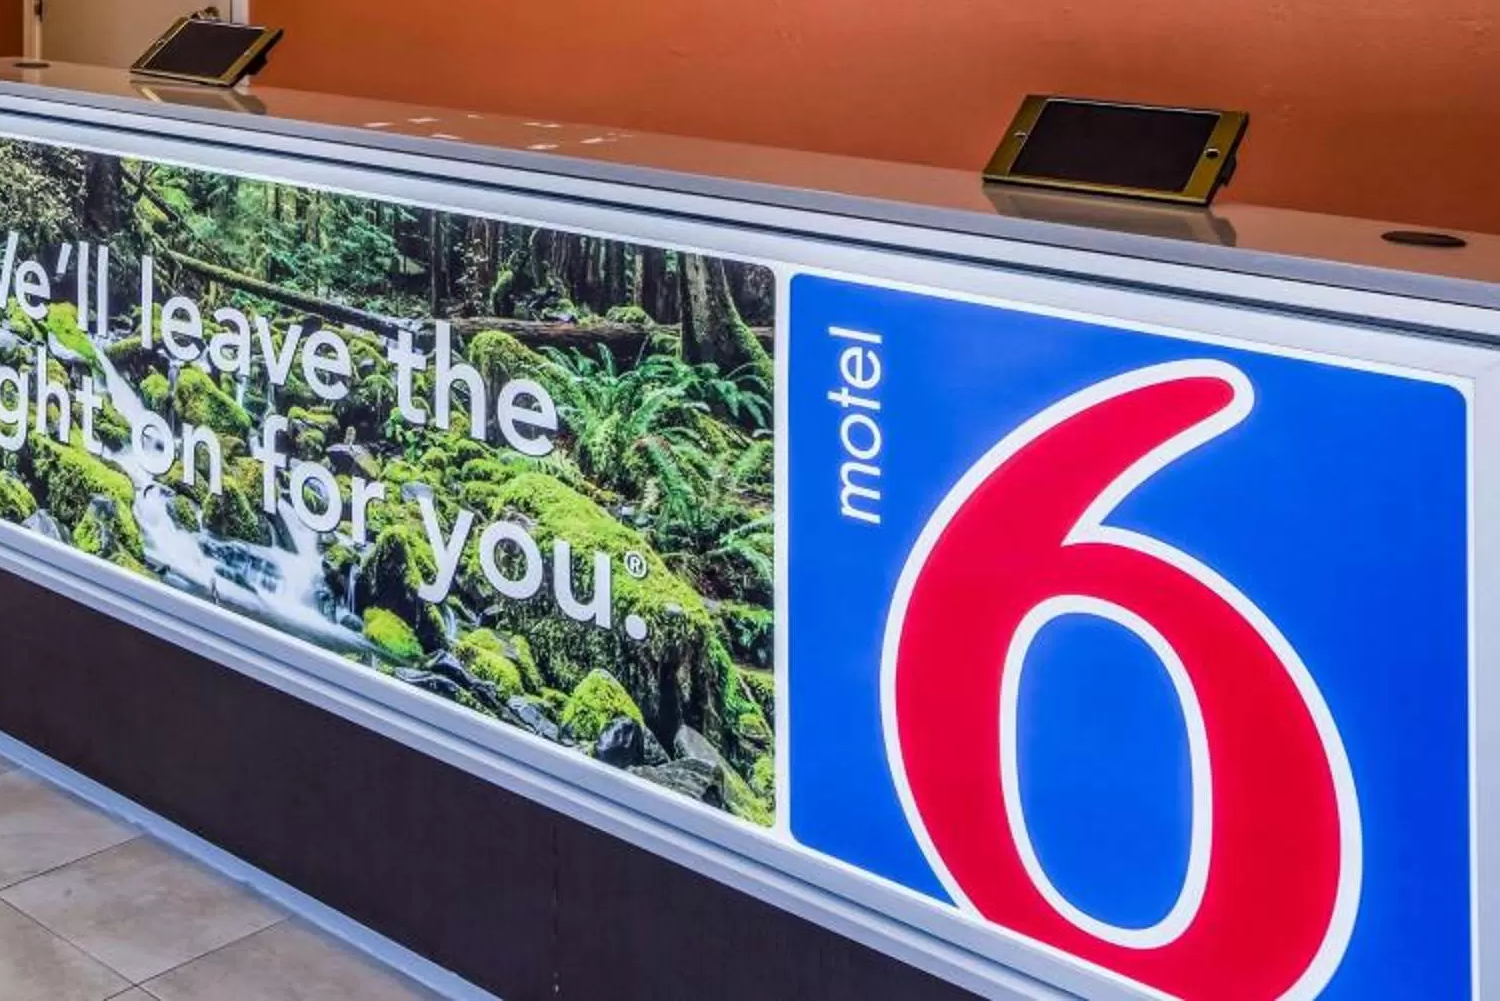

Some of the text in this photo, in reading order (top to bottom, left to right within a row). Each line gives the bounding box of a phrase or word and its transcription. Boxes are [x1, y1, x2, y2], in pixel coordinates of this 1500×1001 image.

[140, 254, 352, 400] leave
[386, 319, 560, 458] the
[130, 419, 222, 497] on
[251, 415, 385, 547] for
[828, 326, 1363, 1001] motel 6
